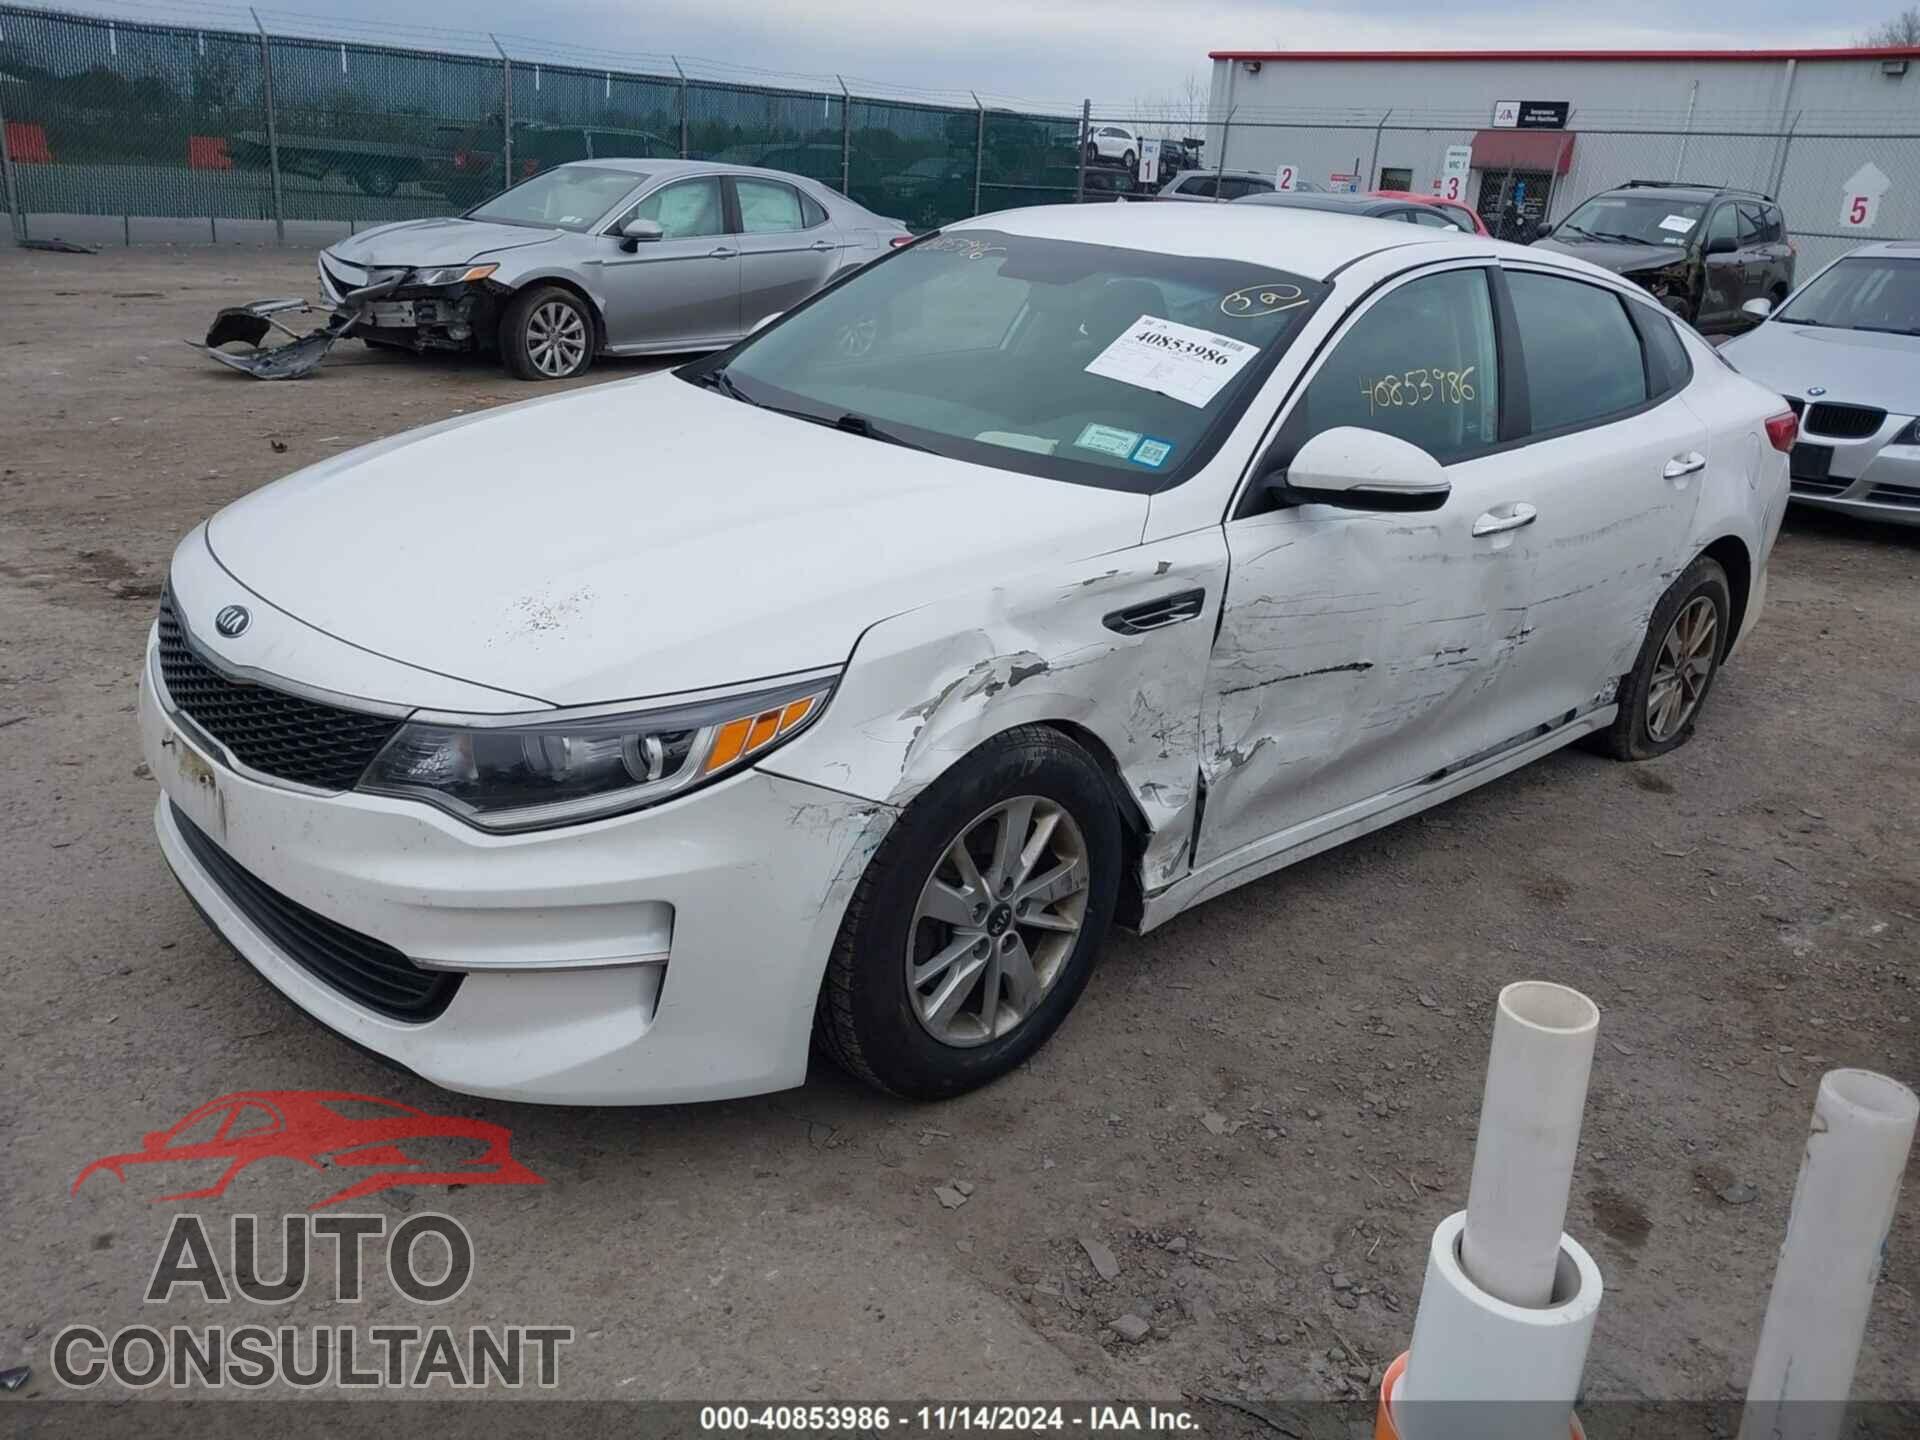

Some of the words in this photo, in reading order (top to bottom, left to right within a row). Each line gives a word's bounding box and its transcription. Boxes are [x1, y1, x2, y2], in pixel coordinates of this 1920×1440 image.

[1144, 160, 1150, 180] 1
[1280, 168, 1292, 189] 2
[1447, 177, 1459, 200] 3
[1850, 197, 1868, 224] 5
[1135, 330, 1229, 366] 40853986
[1360, 366, 1475, 416] 40853986
